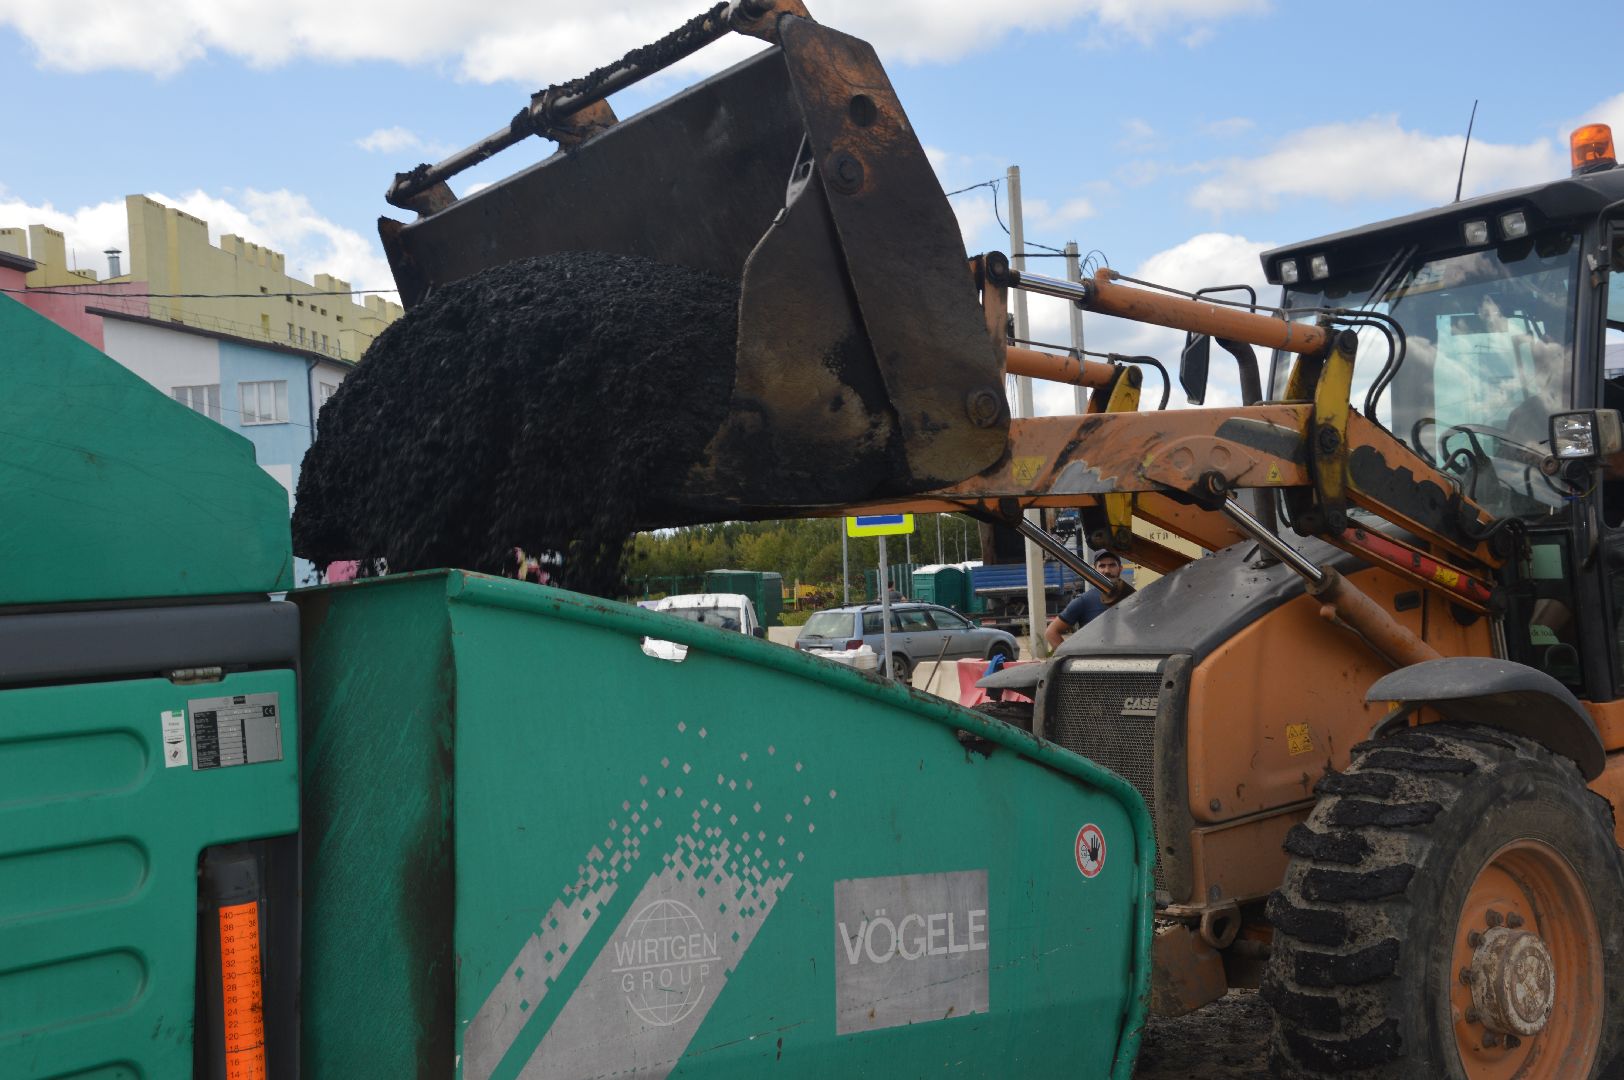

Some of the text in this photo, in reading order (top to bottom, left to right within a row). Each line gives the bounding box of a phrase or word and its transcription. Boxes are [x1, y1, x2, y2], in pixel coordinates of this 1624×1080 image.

[1123, 697, 1159, 710] CASE
[614, 932, 717, 967] WIRTGEN
[838, 909, 987, 965] VÖGELE
[621, 964, 710, 993] GROUP
